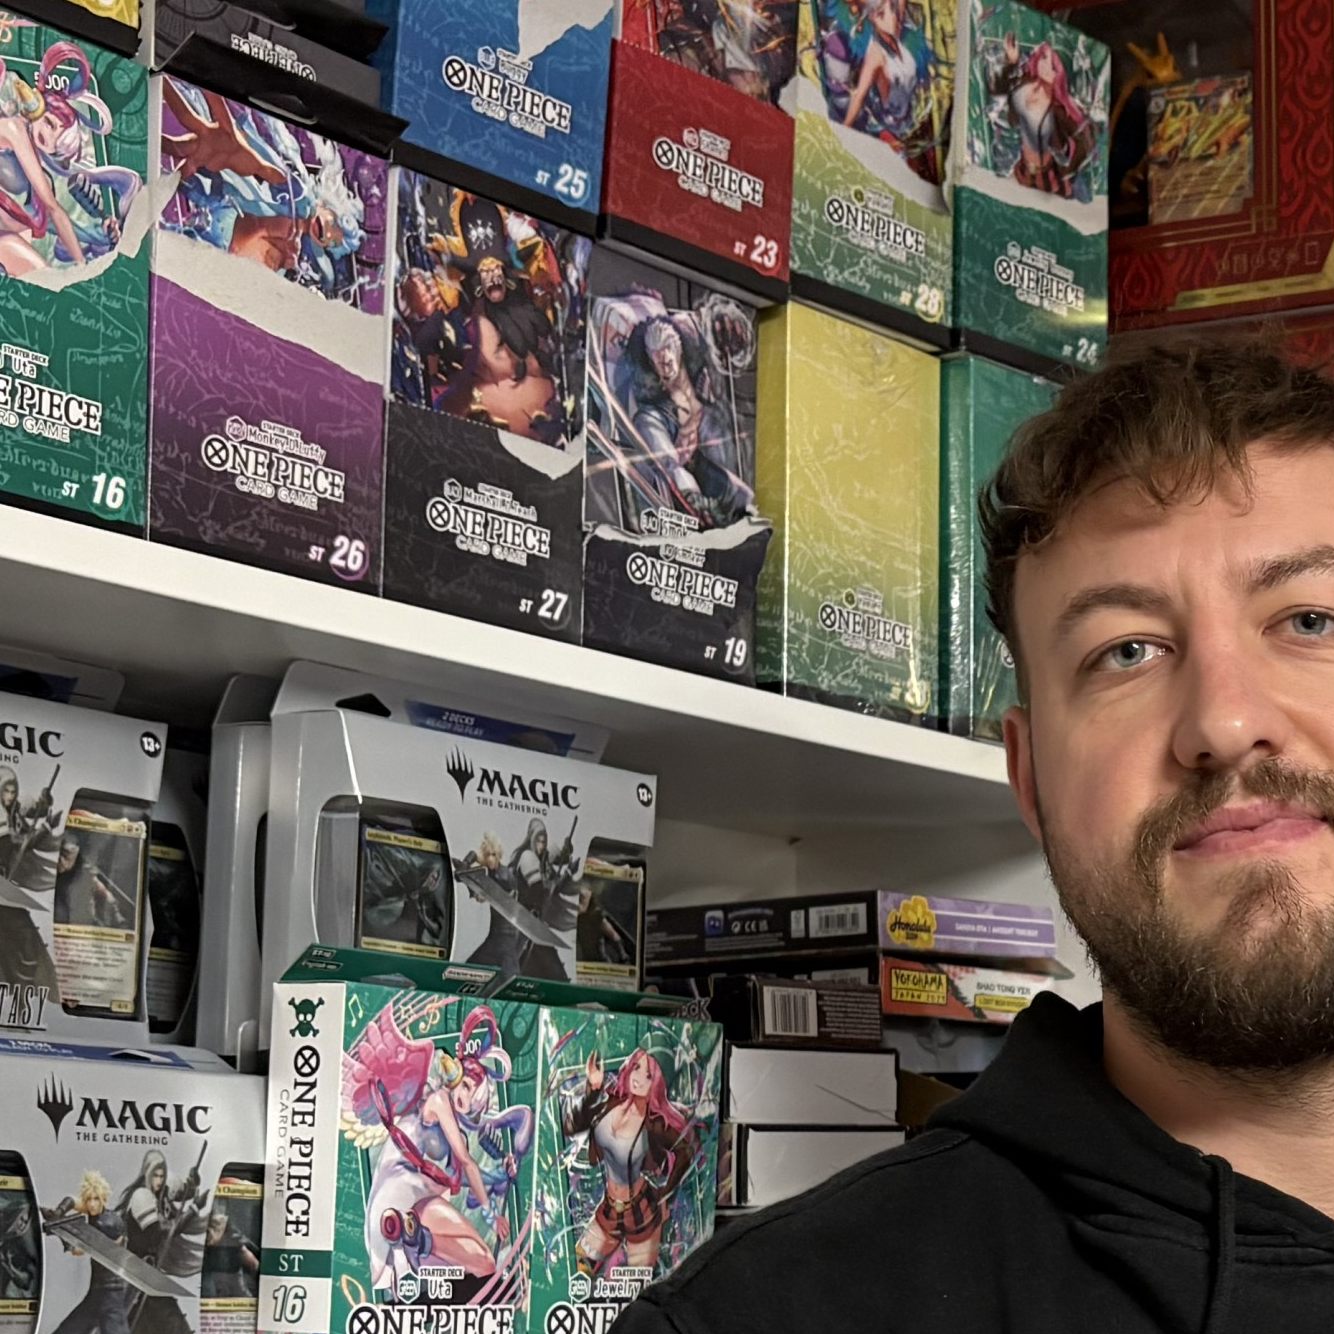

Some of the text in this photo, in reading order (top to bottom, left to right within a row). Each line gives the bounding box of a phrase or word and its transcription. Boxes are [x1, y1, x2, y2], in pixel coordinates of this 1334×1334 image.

[444, 57, 570, 131] ONE PIECE
[535, 163, 588, 199] ST 25
[655, 139, 704, 179] ONE
[708, 160, 763, 205] PIECE
[826, 198, 870, 232] ONE
[874, 216, 925, 255] PIECE
[750, 235, 778, 268] 23
[915, 284, 941, 316] 28
[996, 256, 1037, 291] ONE
[1040, 275, 1085, 311] PIECE
[12, 357, 36, 377] Uta
[1076, 338, 1099, 365] 24
[16, 382, 100, 432] PIECE
[24, 418, 70, 441] GAME
[203, 436, 344, 500] ONE PIECE
[62, 472, 126, 508] ST 16
[236, 476, 317, 511] CARD GAME
[429, 499, 548, 557] ONE PIECE
[308, 536, 365, 572] ST 26
[628, 553, 678, 591] ONE
[681, 568, 738, 607] PIECE
[519, 588, 568, 621] ST 27
[820, 603, 862, 635] ONE
[865, 614, 913, 648] PIECE
[725, 637, 747, 666] 19
[448, 713, 476, 726] DECKS
[0, 722, 64, 758] GIC
[477, 766, 581, 811] MAGIC
[477, 796, 548, 817] THE GATHERING
[890, 914, 931, 933] Honolulu
[893, 970, 944, 990] YOKOHAMA
[0, 983, 49, 1026] TASY
[75, 1097, 213, 1134] MAGIC
[76, 1132, 168, 1146] THE GATHERING
[273, 1088, 291, 1199] CARD GAME
[284, 1045, 321, 1237] ONE PIECE
[278, 1255, 304, 1273] ST
[419, 1268, 464, 1278] STARTER DECK
[612, 1268, 635, 1278] STARTER
[273, 1285, 307, 1324] 16
[428, 1279, 452, 1298] Uta
[594, 1279, 640, 1300] Jewelry
